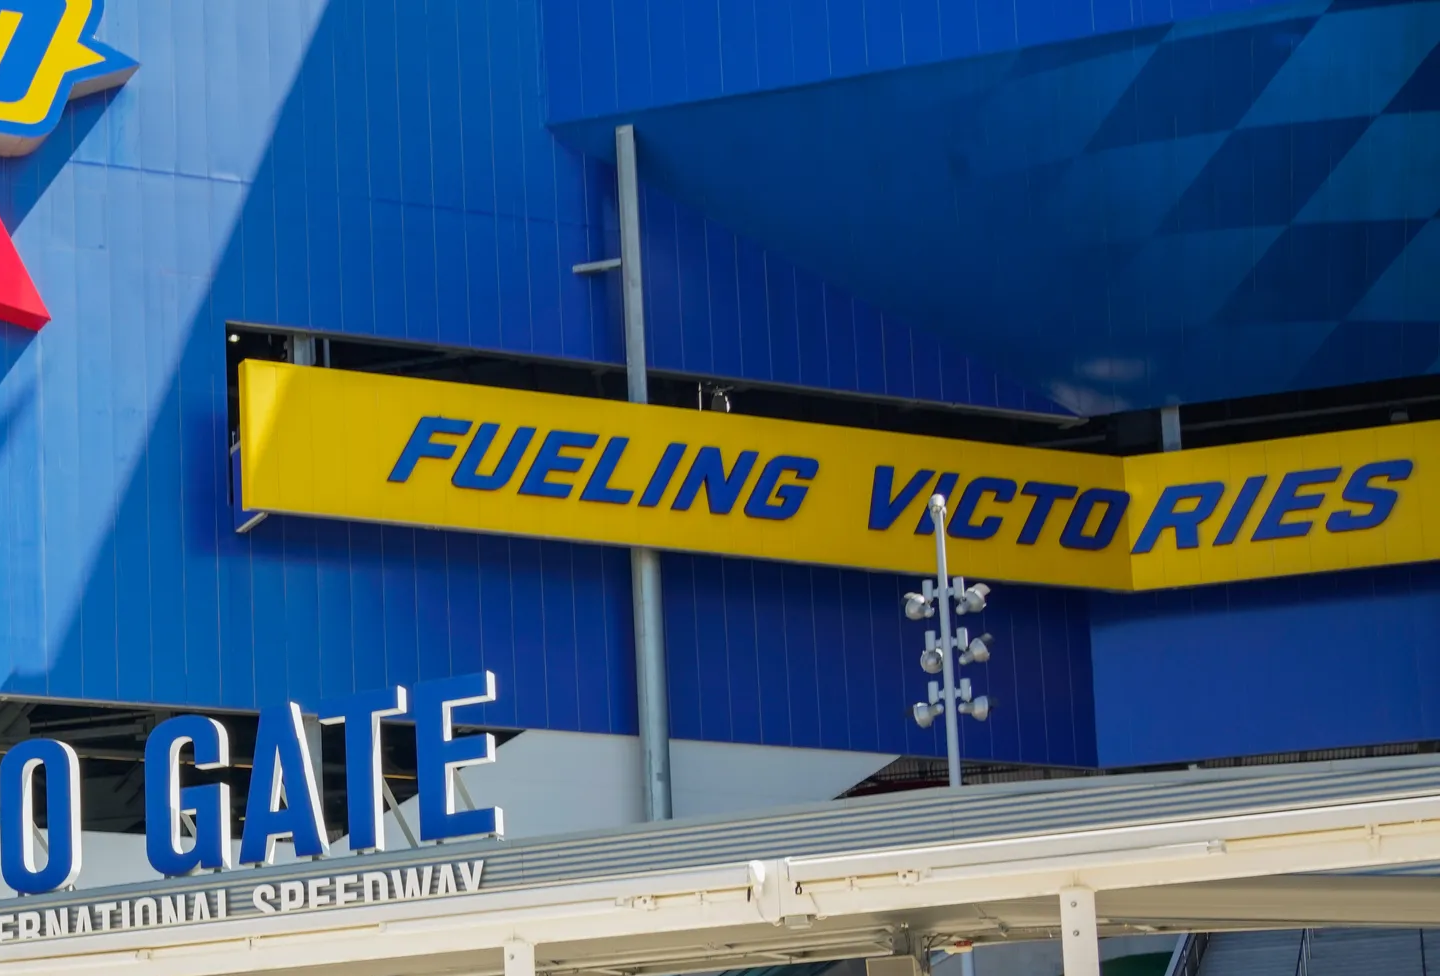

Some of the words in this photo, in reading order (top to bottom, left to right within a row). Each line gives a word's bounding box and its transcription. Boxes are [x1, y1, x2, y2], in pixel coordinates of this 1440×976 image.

[388, 414, 820, 521] FUELING
[867, 458, 1414, 556] VICTORIES
[144, 670, 503, 878] GATE
[252, 859, 485, 914] SPEEDWAY
